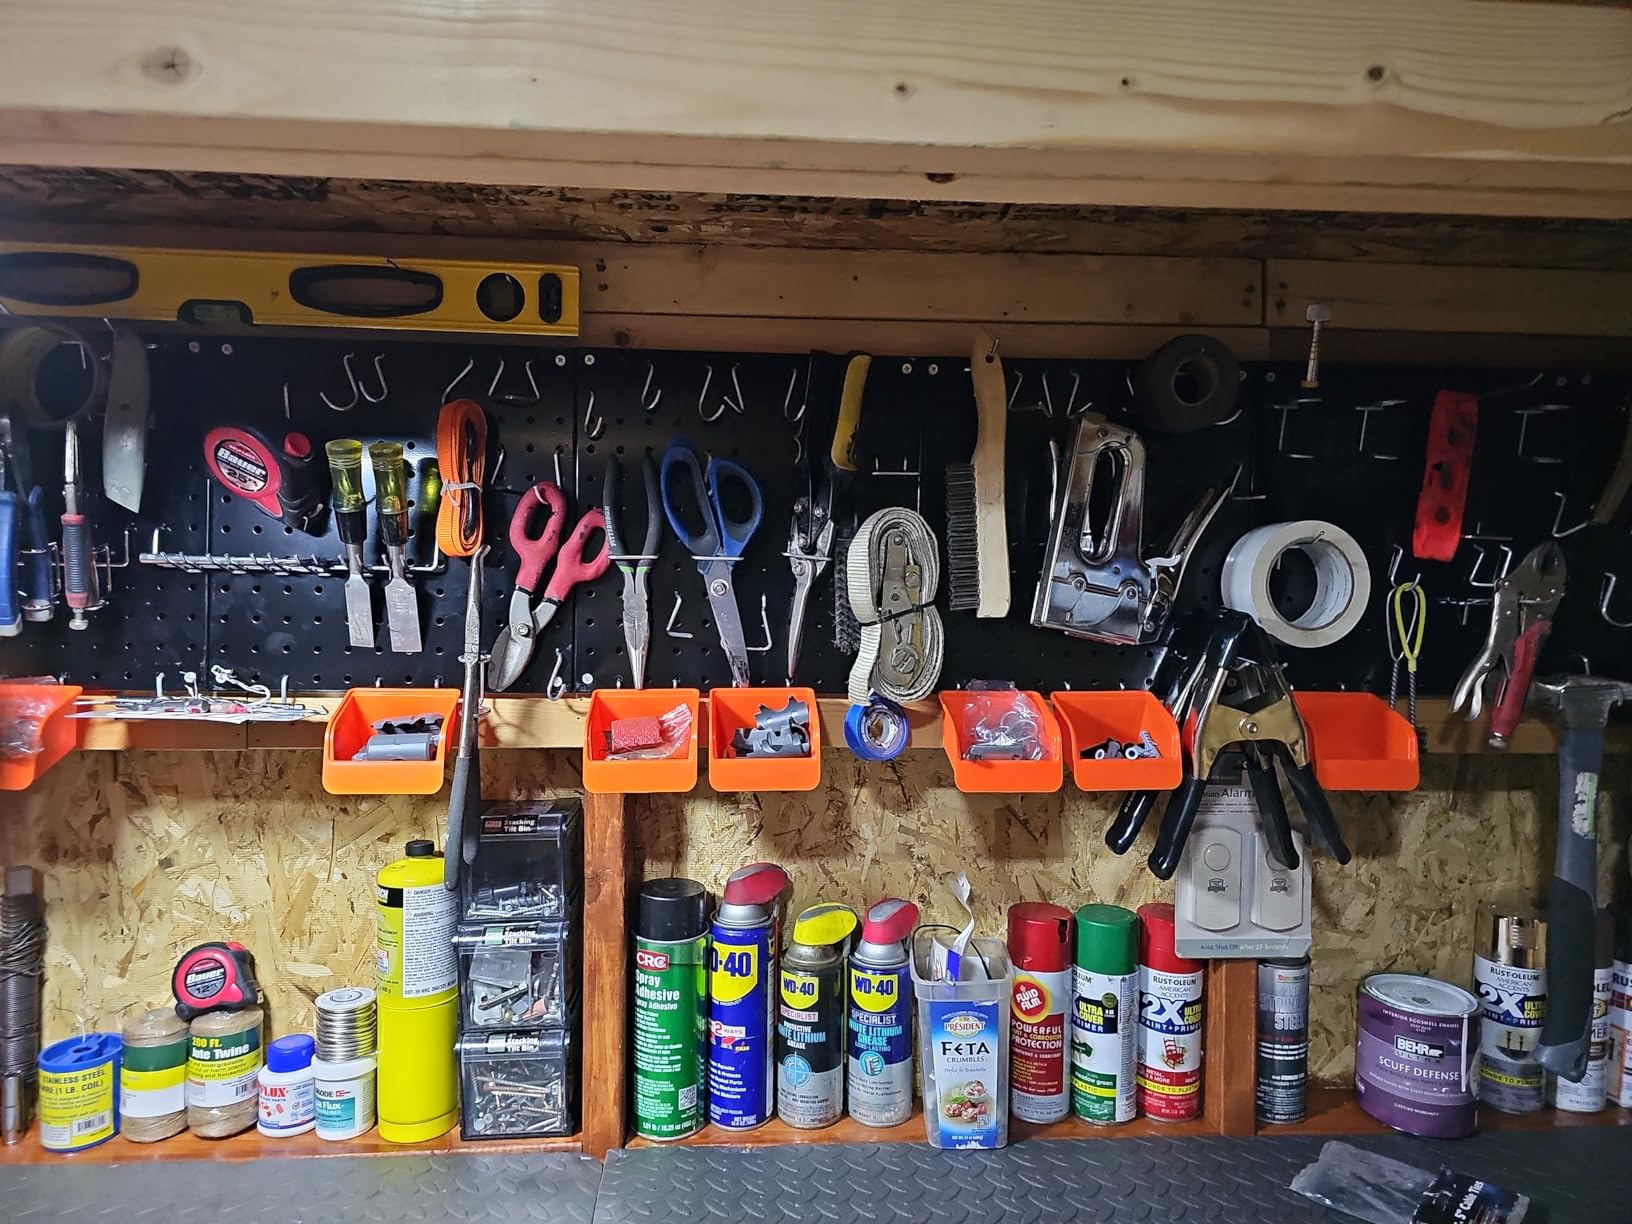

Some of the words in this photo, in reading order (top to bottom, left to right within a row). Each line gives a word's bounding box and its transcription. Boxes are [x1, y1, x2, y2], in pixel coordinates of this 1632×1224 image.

[217, 447, 267, 476] Bauer
[503, 819, 536, 827] Stacking
[503, 930, 537, 939] Stacking
[503, 937, 518, 945] Tilt
[636, 951, 667, 969] CRC
[711, 947, 752, 978] D-40
[186, 968, 225, 985] Bauer
[635, 968, 661, 988] Spray
[1153, 975, 1197, 986] RUST-OLEUM
[1489, 966, 1540, 982] RUST-OLEUM
[784, 977, 815, 996] WD-40
[854, 974, 894, 996] WD-40
[1158, 985, 1191, 993] AMERICAN
[1496, 977, 1532, 988] AMERICAN
[1499, 983, 1530, 993] ACCENTS
[635, 983, 680, 1001] Adhesive
[1016, 988, 1039, 1004] FLUID
[1160, 991, 1189, 999] ACCENTS
[648, 1000, 678, 1010] Adhesivo
[1021, 997, 1041, 1011] FILM
[1079, 1000, 1104, 1017] ULTRA
[1479, 983, 1525, 1019] 2X
[781, 1005, 817, 1021] SPECIALIST
[851, 1009, 897, 1025] SPECIALIST
[1141, 993, 1185, 1026] 2X
[1079, 1010, 1104, 1026] COVER
[1382, 1009, 1408, 1021] INTERIOR
[1409, 1017, 1438, 1028] EGGSHELL
[783, 1020, 812, 1033] PROTECTIVE
[868, 1025, 903, 1037] LITHIUM
[945, 1021, 985, 1031] PRÉSIDENT
[1011, 1019, 1062, 1035] POWERFUL
[192, 1036, 207, 1049] 200
[506, 1037, 540, 1046] Stacking
[787, 1039, 806, 1050] GREASE
[792, 1030, 827, 1044] LITHIUM
[857, 1032, 888, 1047] GREASE
[1011, 1034, 1062, 1050] PROTECTION
[1029, 1033, 1062, 1041] CORROSION
[191, 1046, 211, 1060] Jute
[213, 1043, 250, 1060] Twine
[506, 1044, 520, 1053] Tilt
[521, 1044, 534, 1052] Bin
[940, 1041, 990, 1056] FETA
[1396, 1037, 1430, 1057] BEHR
[1395, 1050, 1441, 1064] ULTRA
[1378, 1055, 1411, 1074] SCUFF
[1413, 1066, 1461, 1081] DEFENSE
[1480, 1069, 1503, 1081] BONDS
[43, 1075, 80, 1085] STAINLESS
[82, 1068, 106, 1082] STEEL
[81, 1078, 104, 1092] COIL)
[1074, 1079, 1098, 1094] PLASTIC
[1143, 1080, 1165, 1092] BONDS
[1393, 1102, 1414, 1113] LIFETIME
[1414, 1107, 1440, 1117] WARRANTY
[1468, 1180, 1485, 1194] Ties
[1459, 1193, 1478, 1211] Cable
